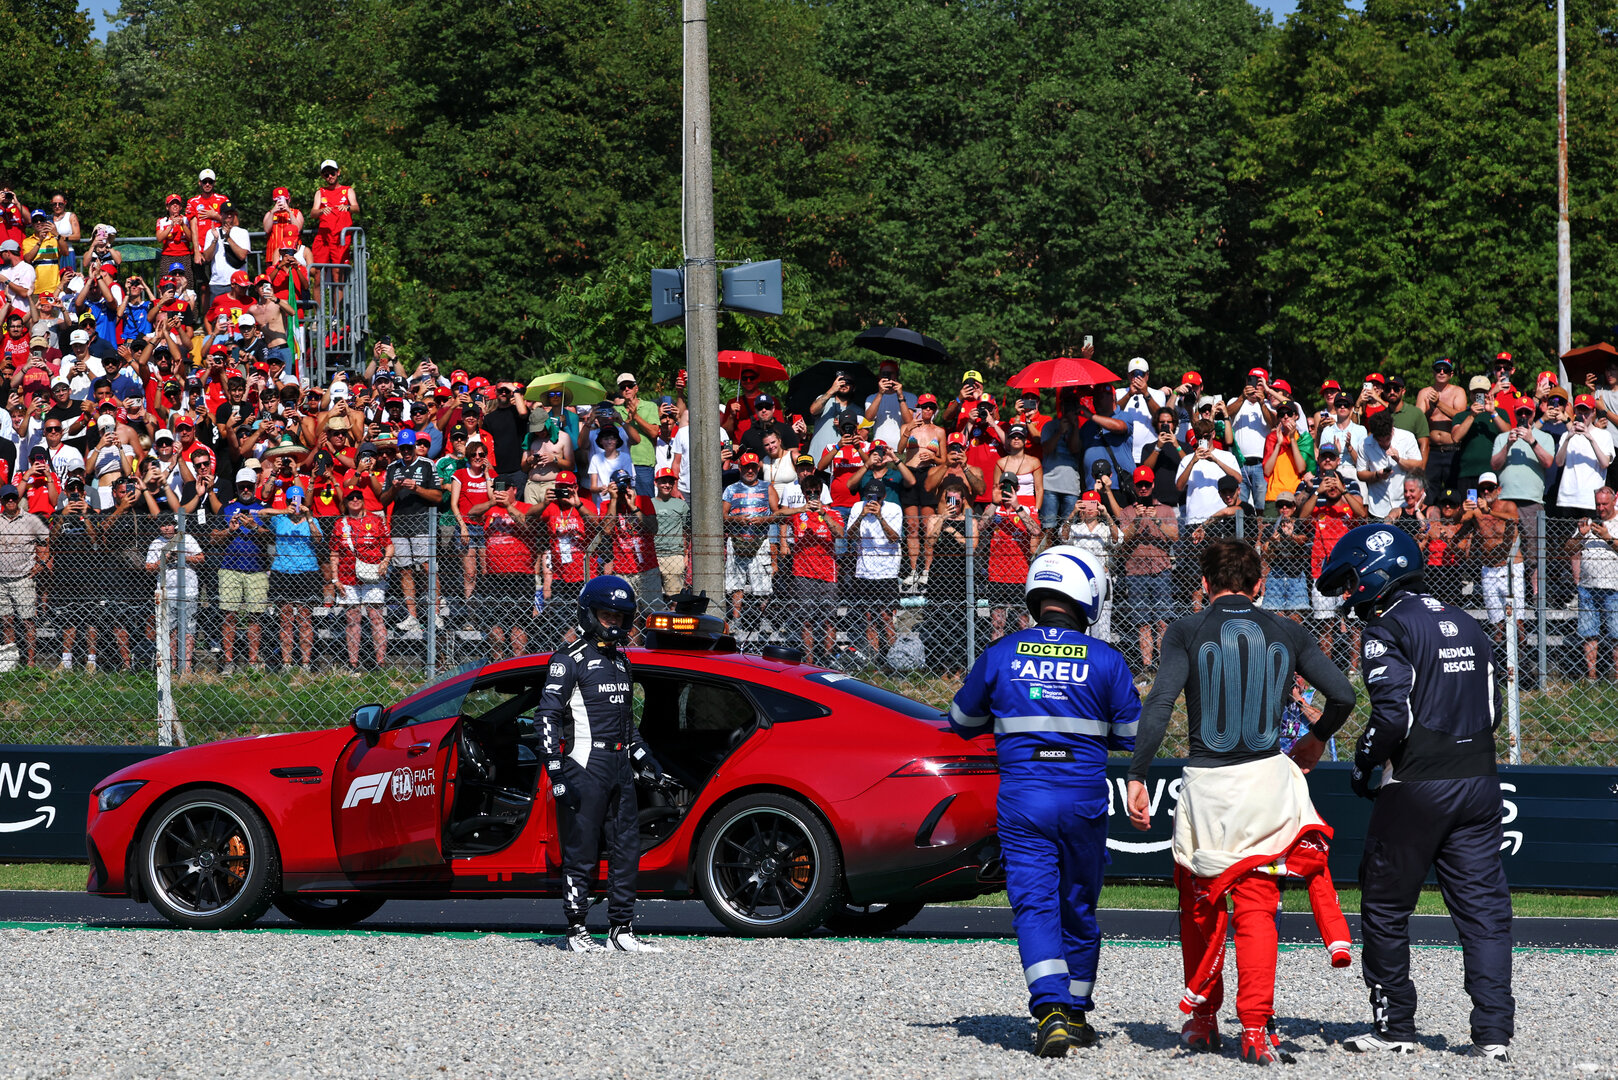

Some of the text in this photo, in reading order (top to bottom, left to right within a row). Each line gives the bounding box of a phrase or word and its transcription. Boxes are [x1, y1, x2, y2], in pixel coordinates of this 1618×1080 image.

[1020, 643, 1084, 657] DOCTOR
[1439, 646, 1475, 659] MEDICAL
[1019, 660, 1089, 683] AREU
[1443, 660, 1475, 673] RESCUE
